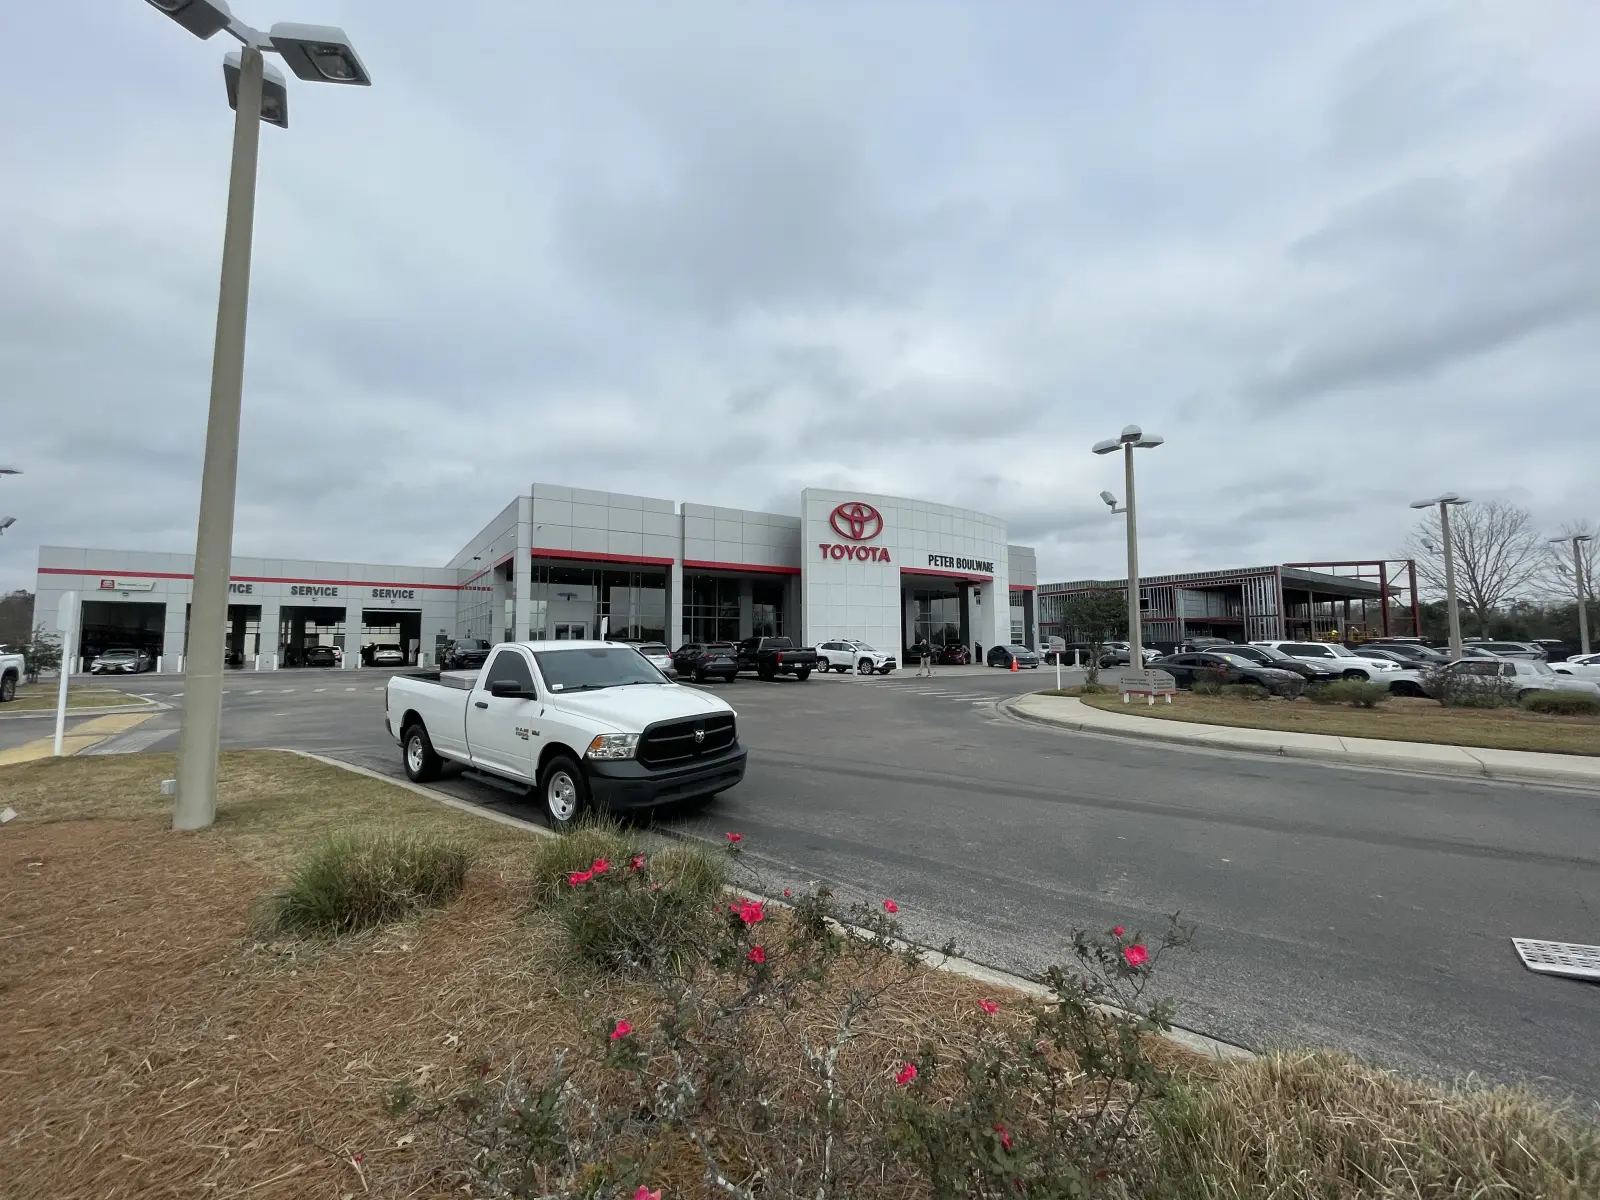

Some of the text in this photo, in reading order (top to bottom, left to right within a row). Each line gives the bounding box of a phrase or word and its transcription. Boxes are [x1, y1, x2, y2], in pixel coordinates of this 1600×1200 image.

[819, 544, 891, 563] TOYOTA
[928, 554, 994, 573] PETER BOULWARE
[290, 586, 338, 597] SERVICE
[371, 588, 415, 599] SERVICE
